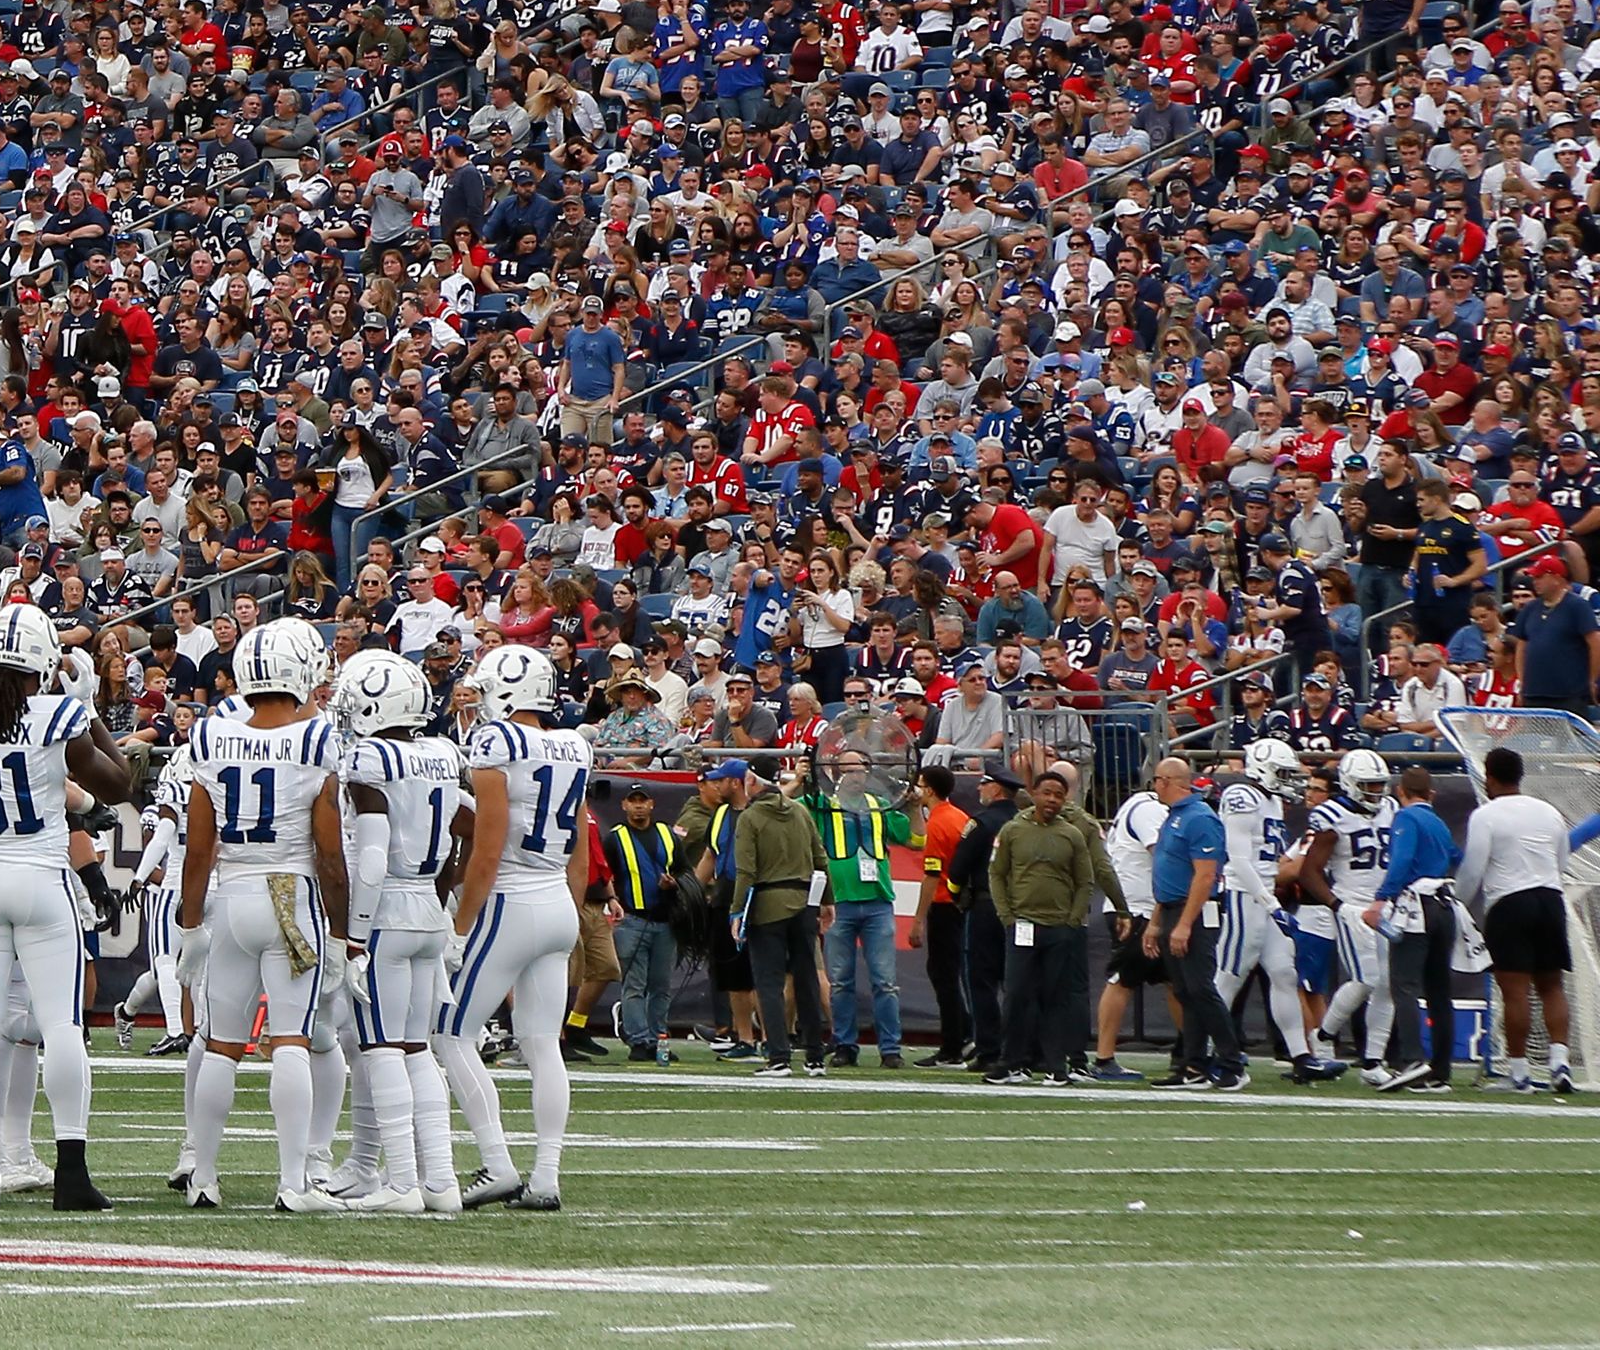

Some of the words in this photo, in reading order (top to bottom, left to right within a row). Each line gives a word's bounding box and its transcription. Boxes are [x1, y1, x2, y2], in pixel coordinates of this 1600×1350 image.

[24, 32, 45, 52] 10
[1257, 74, 1283, 96] 11
[260, 364, 282, 387] 11
[756, 599, 790, 637] 28
[215, 737, 270, 760] PITTMAN
[275, 733, 293, 759] JR
[475, 732, 495, 756] 14
[541, 739, 582, 762] PIERCE
[351, 752, 360, 771] 1
[217, 766, 278, 844] 11
[520, 765, 587, 855] 14
[416, 788, 442, 876] 1
[1348, 826, 1392, 868] 58
